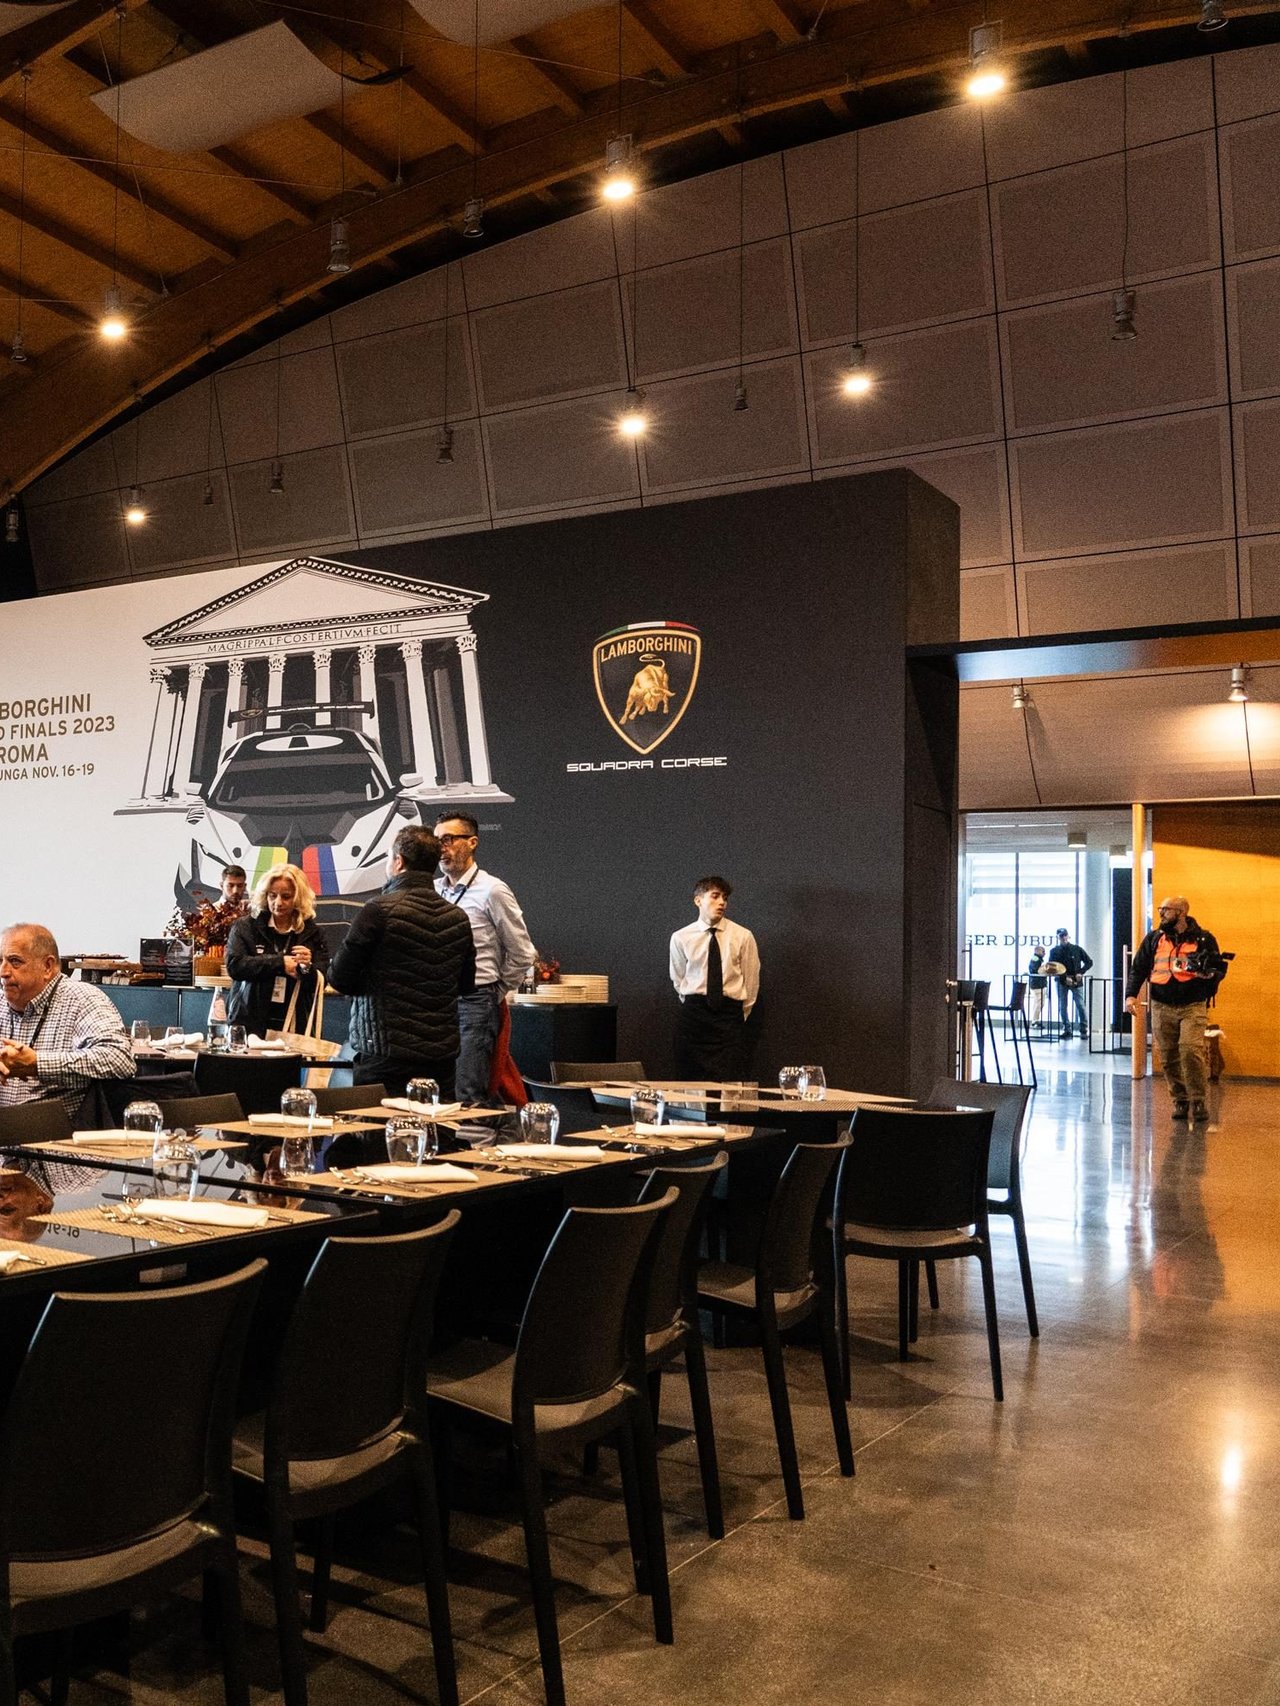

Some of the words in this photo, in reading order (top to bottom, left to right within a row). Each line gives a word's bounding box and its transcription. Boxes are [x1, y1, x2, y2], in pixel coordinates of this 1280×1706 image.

[601, 637, 692, 663] LAMBORGHINI
[10, 719, 68, 740] FINALS
[72, 715, 116, 735] 2023
[32, 765, 60, 780] NOV.
[62, 762, 95, 777] 16-19
[566, 760, 654, 772] SQUADRA
[661, 756, 728, 769] CORSE
